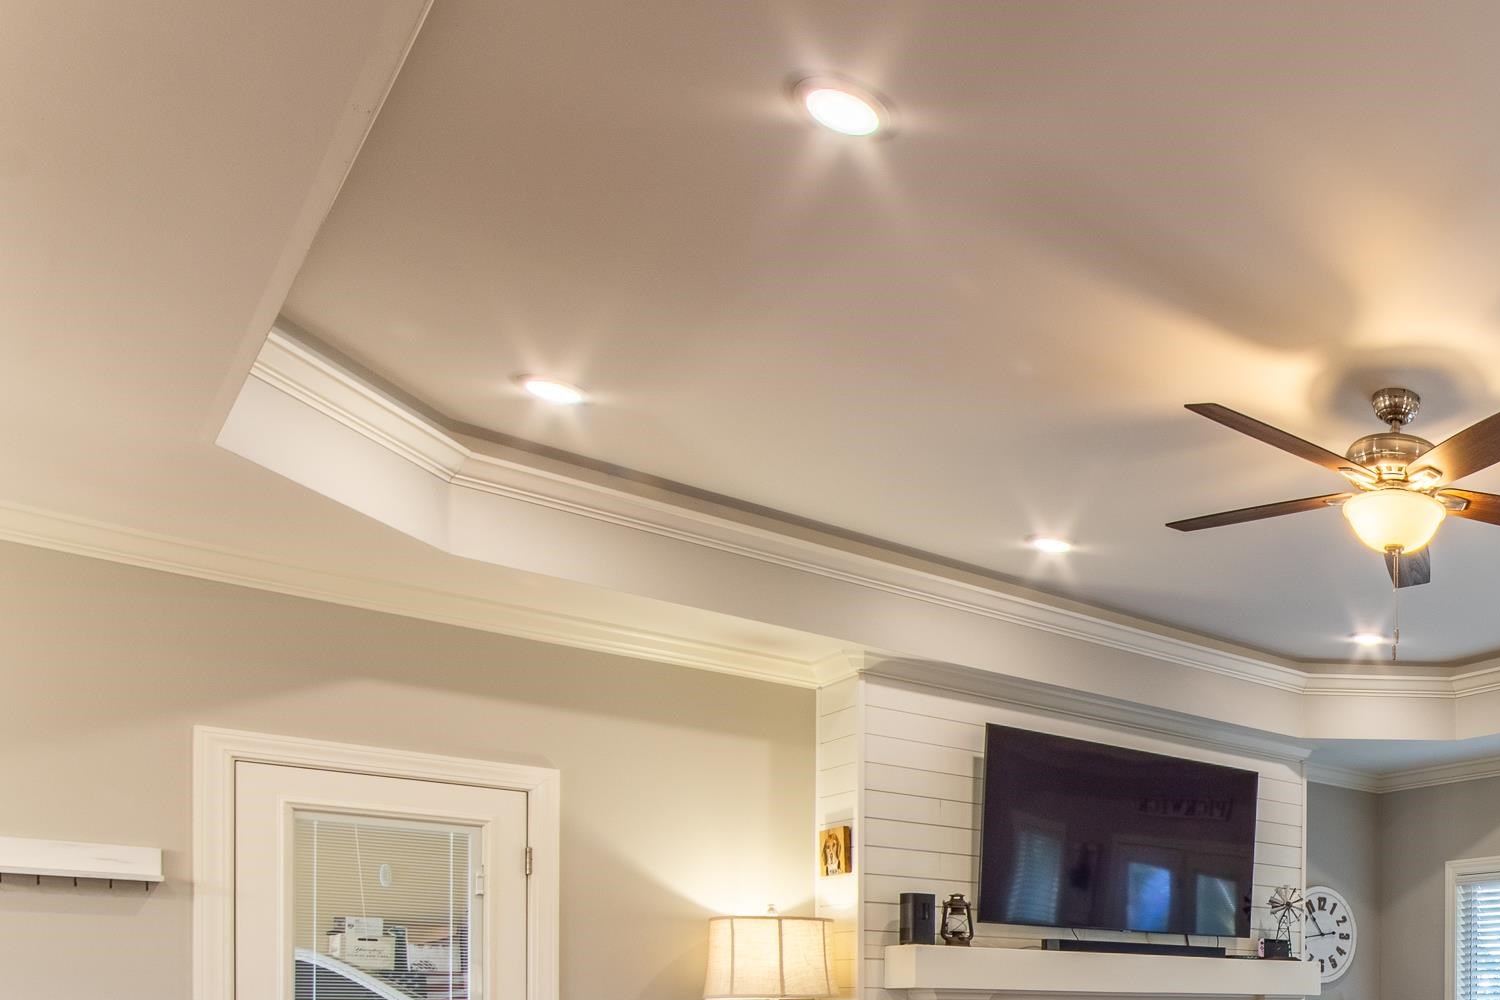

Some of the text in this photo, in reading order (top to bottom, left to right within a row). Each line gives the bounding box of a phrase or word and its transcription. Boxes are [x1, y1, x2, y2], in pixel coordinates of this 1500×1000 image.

[1317, 897, 1327, 911] 12
[1329, 903, 1337, 915] 1
[1336, 915, 1347, 927] 2
[1336, 946, 1347, 956] 4
[1328, 955, 1338, 969] 5
